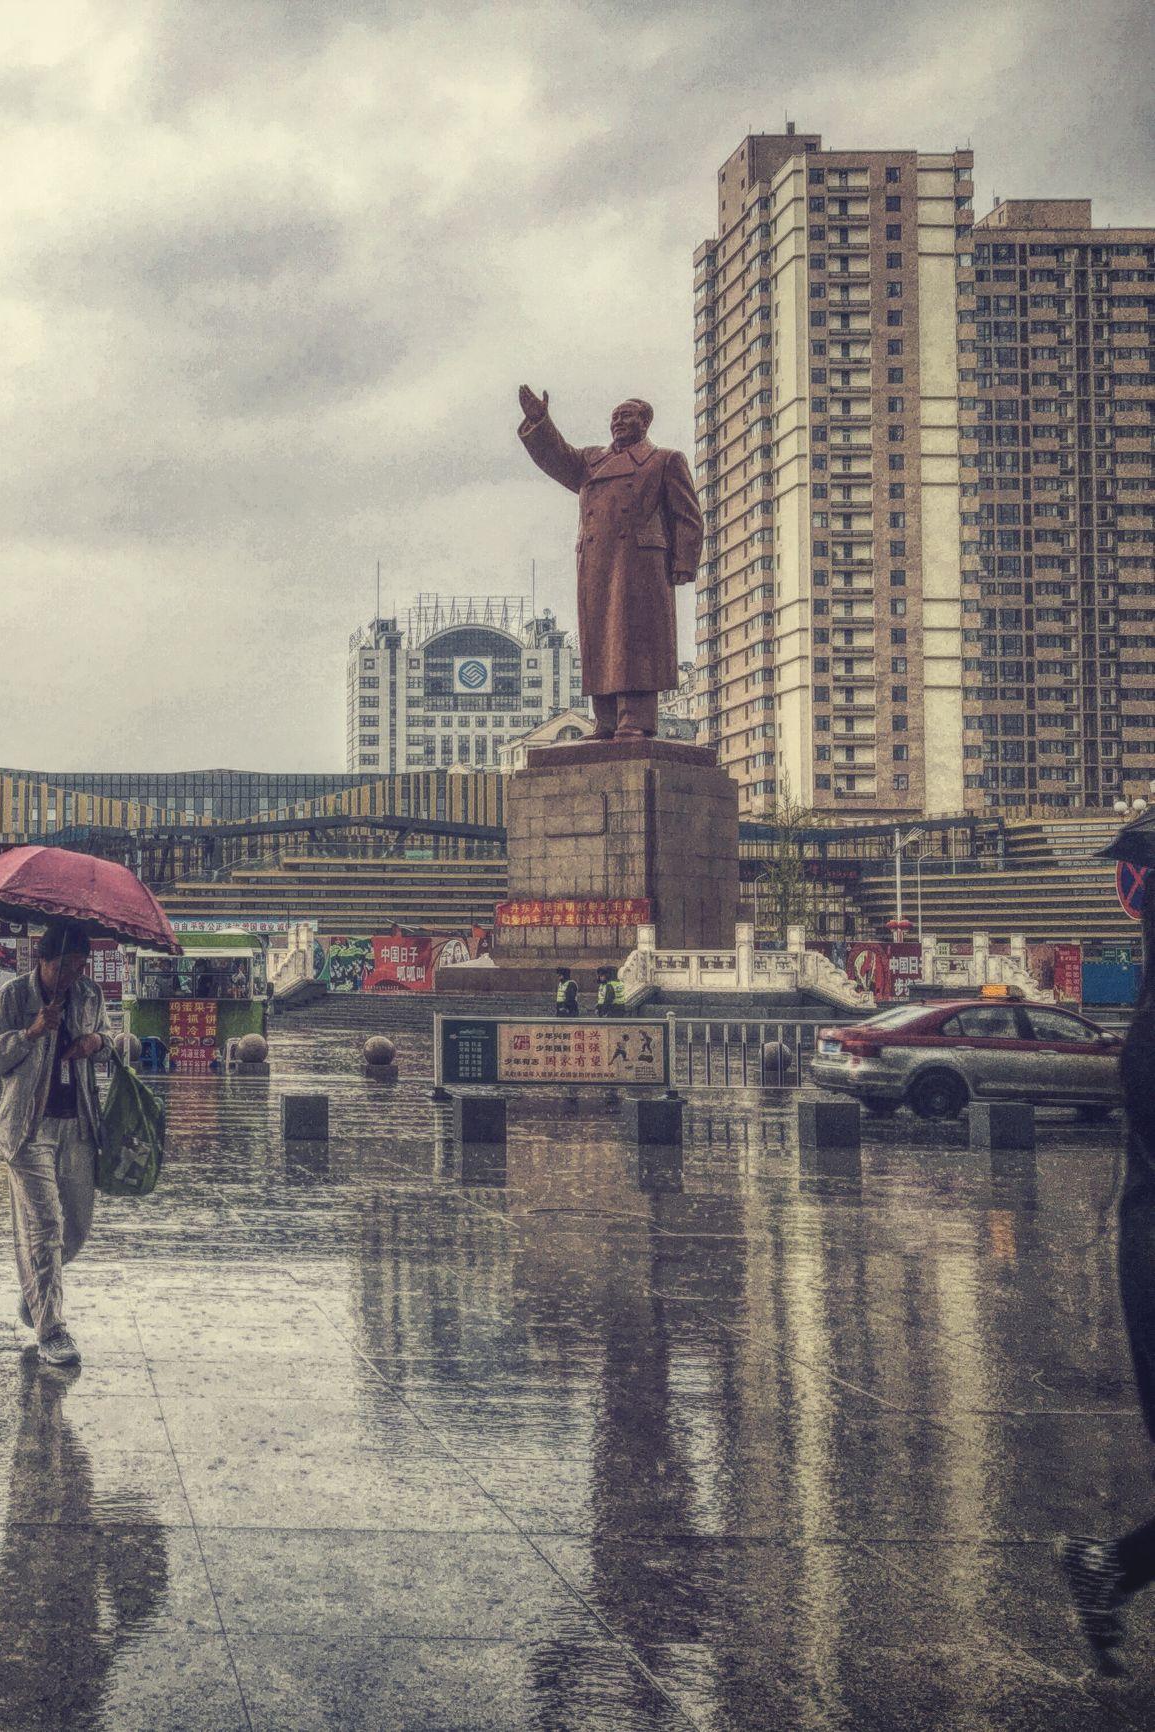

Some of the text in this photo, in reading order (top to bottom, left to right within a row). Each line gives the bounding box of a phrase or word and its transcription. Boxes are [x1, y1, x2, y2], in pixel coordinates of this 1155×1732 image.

[174, 922, 188, 931] 自由
[191, 922, 205, 931] 平等
[208, 922, 222, 931] 公正
[259, 922, 274, 931] 敬业
[381, 945, 418, 963] 中国日子
[889, 956, 922, 974] 中国日
[397, 966, 426, 983] 呱呱叫
[170, 1002, 217, 1012] 鸡蛋果子
[170, 1014, 216, 1024] 手抓饼
[170, 1026, 216, 1036] 烤冷面
[545, 1055, 603, 1067] 国家有望
